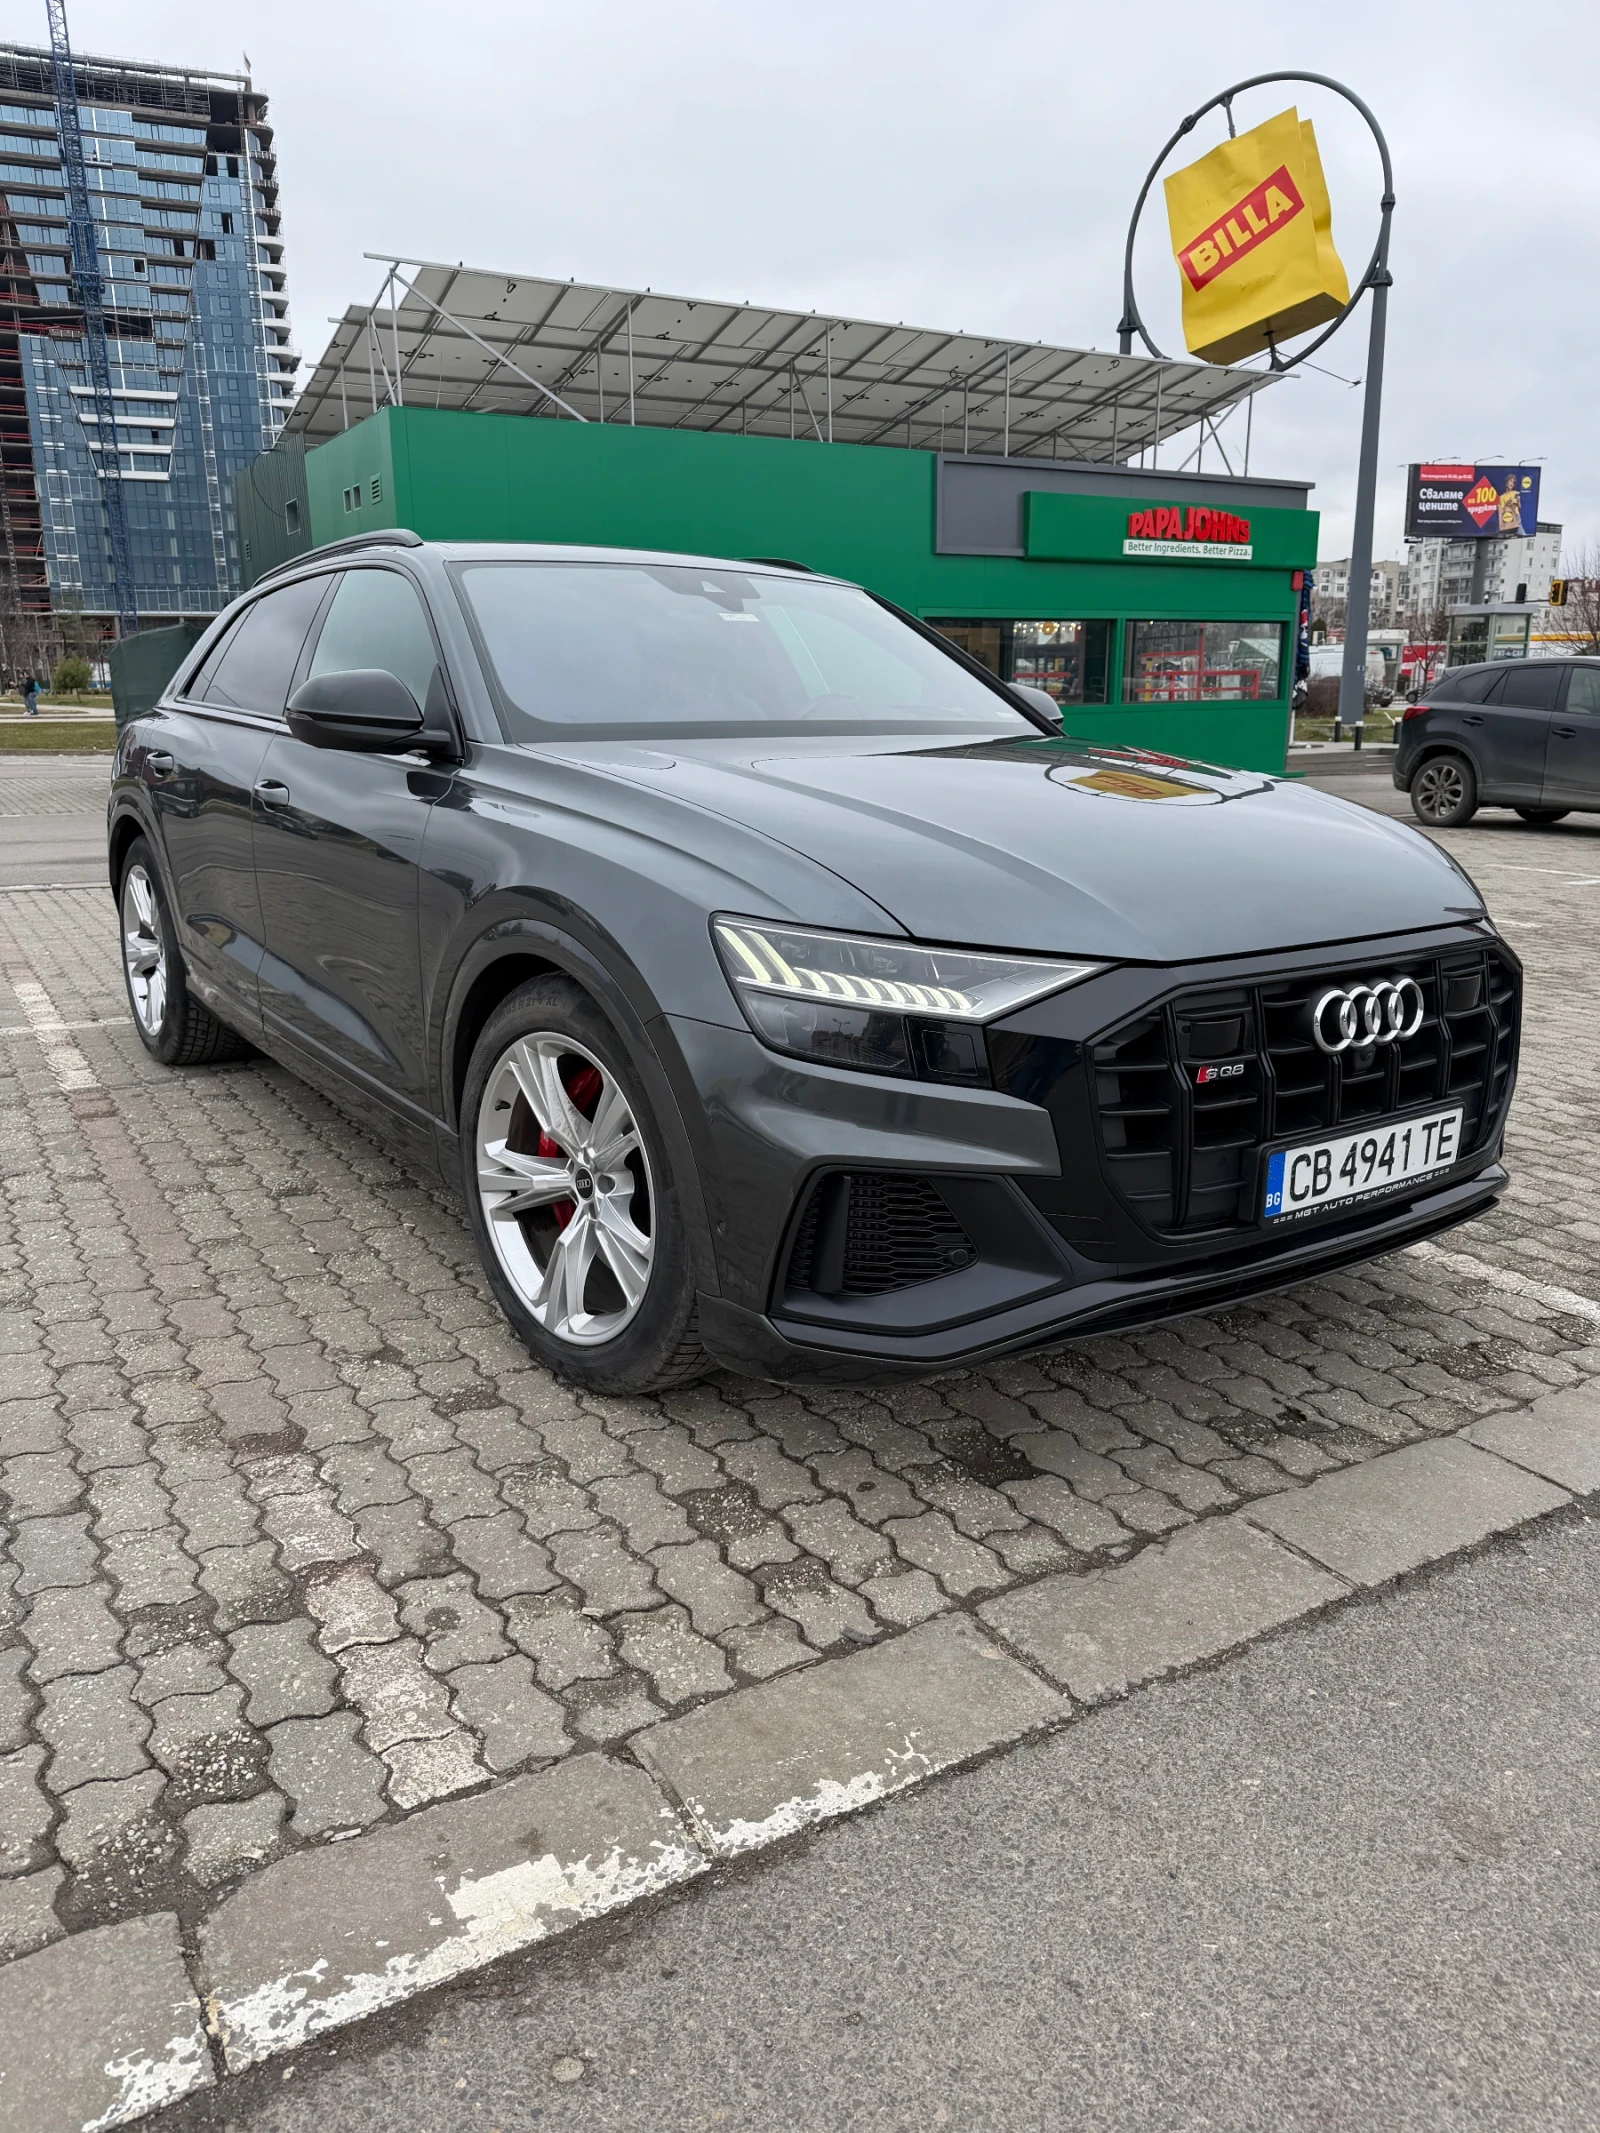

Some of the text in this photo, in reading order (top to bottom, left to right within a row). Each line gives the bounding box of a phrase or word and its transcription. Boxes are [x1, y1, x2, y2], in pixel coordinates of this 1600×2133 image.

[1188, 185, 1294, 276] BILLA
[1420, 488, 1463, 500] Сваляме
[1476, 487, 1497, 503] 100
[1419, 501, 1458, 512] цените
[1128, 507, 1250, 543] PAPA JOHNS
[1128, 542, 1250, 556] Better Ingredients. Better Pizza.
[1290, 1116, 1456, 1202] CB 4941 TE
[1266, 1191, 1280, 1208] BG
[1322, 1197, 1354, 1212] AUTO
[1355, 1171, 1433, 1202] PERFORMANCE
